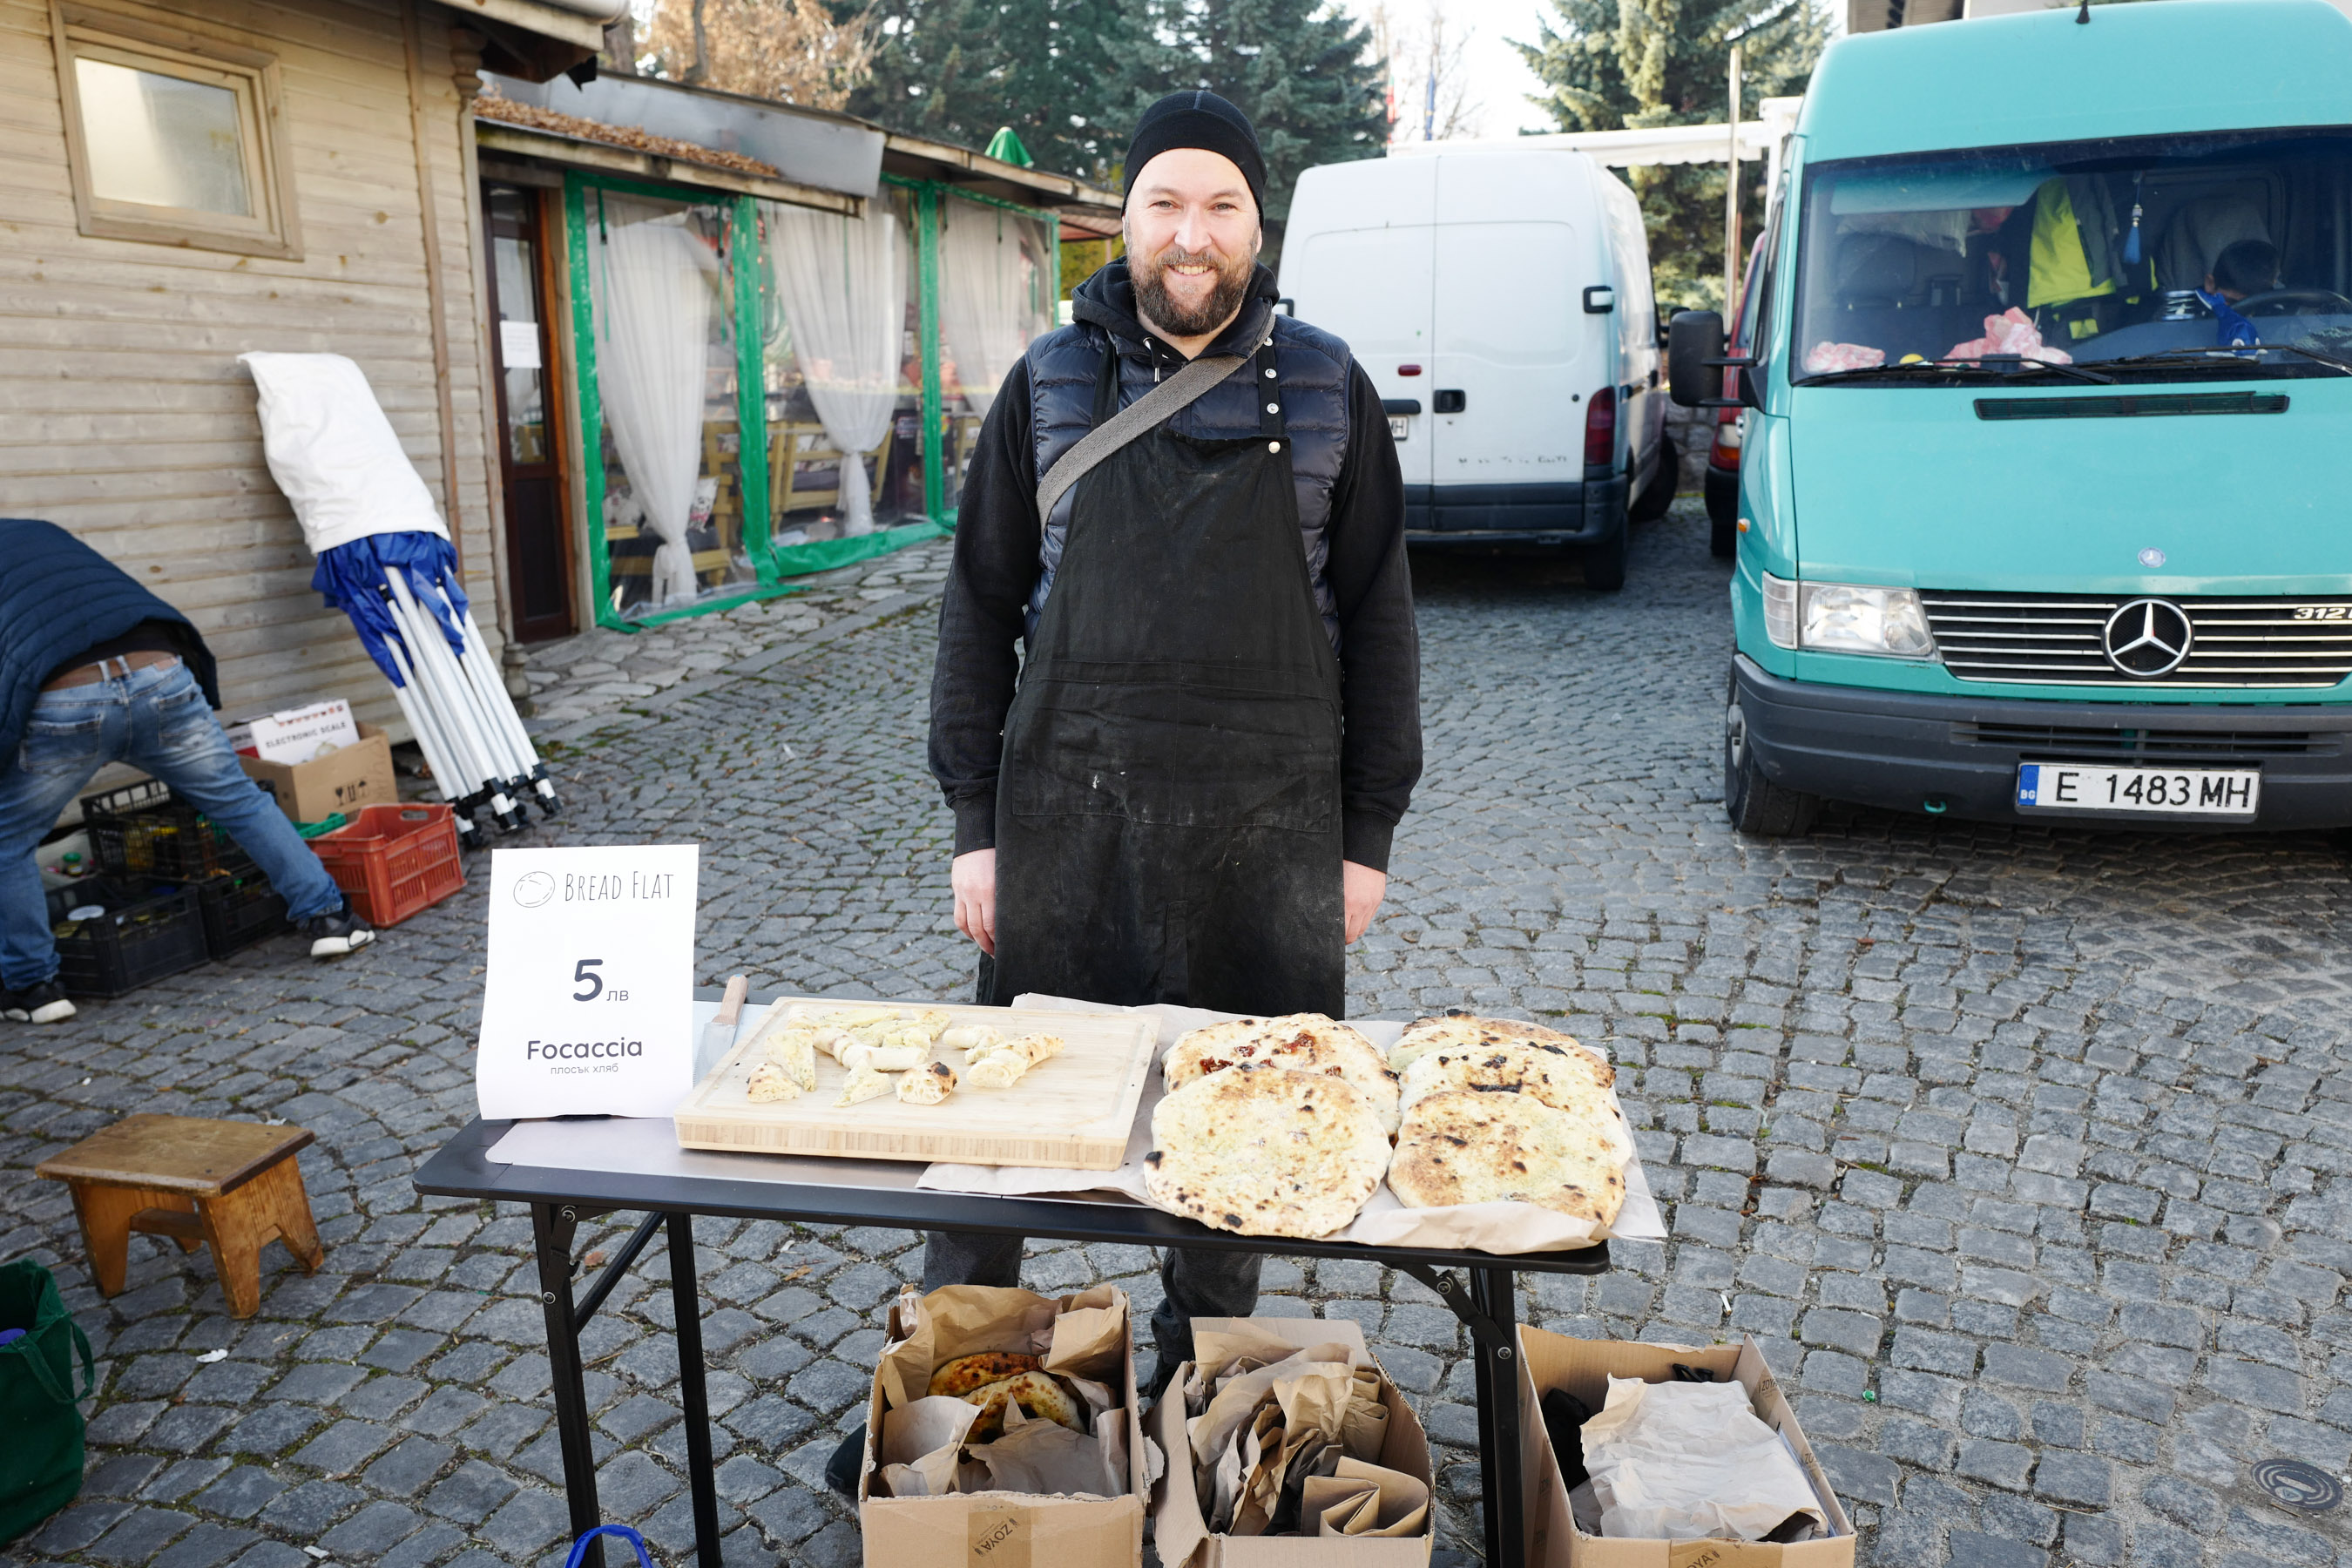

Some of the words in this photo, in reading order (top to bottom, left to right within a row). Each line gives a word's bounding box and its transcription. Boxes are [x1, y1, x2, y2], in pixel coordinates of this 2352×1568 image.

[266, 729, 319, 748] ELECTRONIC
[321, 720, 347, 735] SCALE
[2020, 789, 2036, 800] BG
[2056, 772, 2079, 801] E
[2106, 774, 2191, 806] 1483
[527, 1037, 642, 1060] Focaccia
[592, 1063, 618, 1073] хляб
[980, 1523, 1013, 1551] ZOYA
